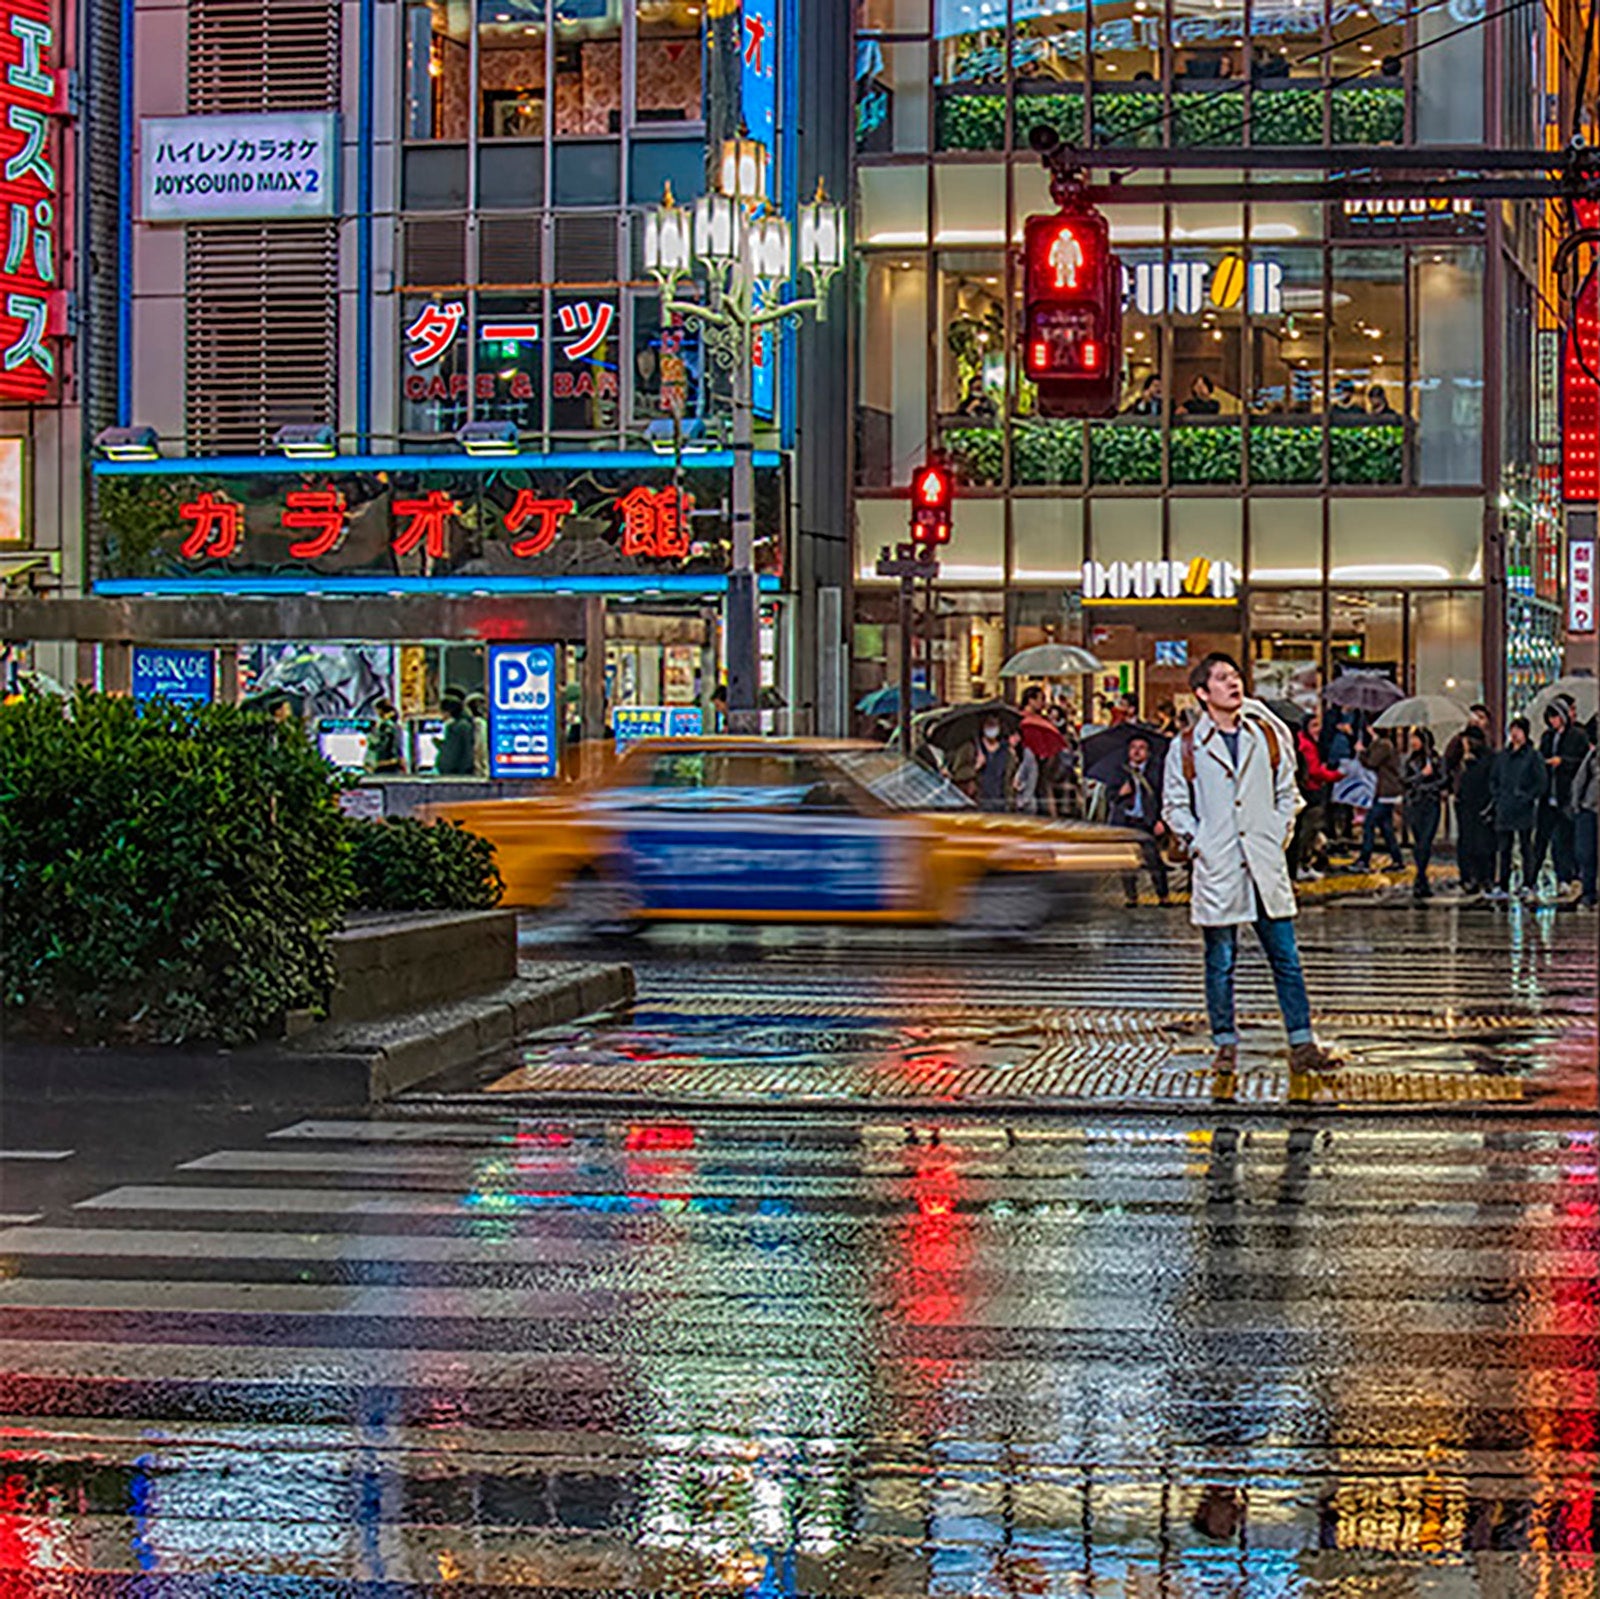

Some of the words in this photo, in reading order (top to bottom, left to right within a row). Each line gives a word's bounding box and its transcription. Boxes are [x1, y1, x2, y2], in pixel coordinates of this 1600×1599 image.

[156, 139, 319, 165] ハイレゾカラオケ
[5, 15, 54, 377] エスパス
[154, 173, 253, 196] JOYSOUND
[1121, 252, 1283, 315] UTOR
[405, 301, 615, 367] ダーツ
[404, 374, 495, 399] CAFE
[510, 374, 535, 399] &
[552, 372, 619, 399] BAR
[180, 487, 688, 559] カラオケ館
[499, 659, 528, 706] P
